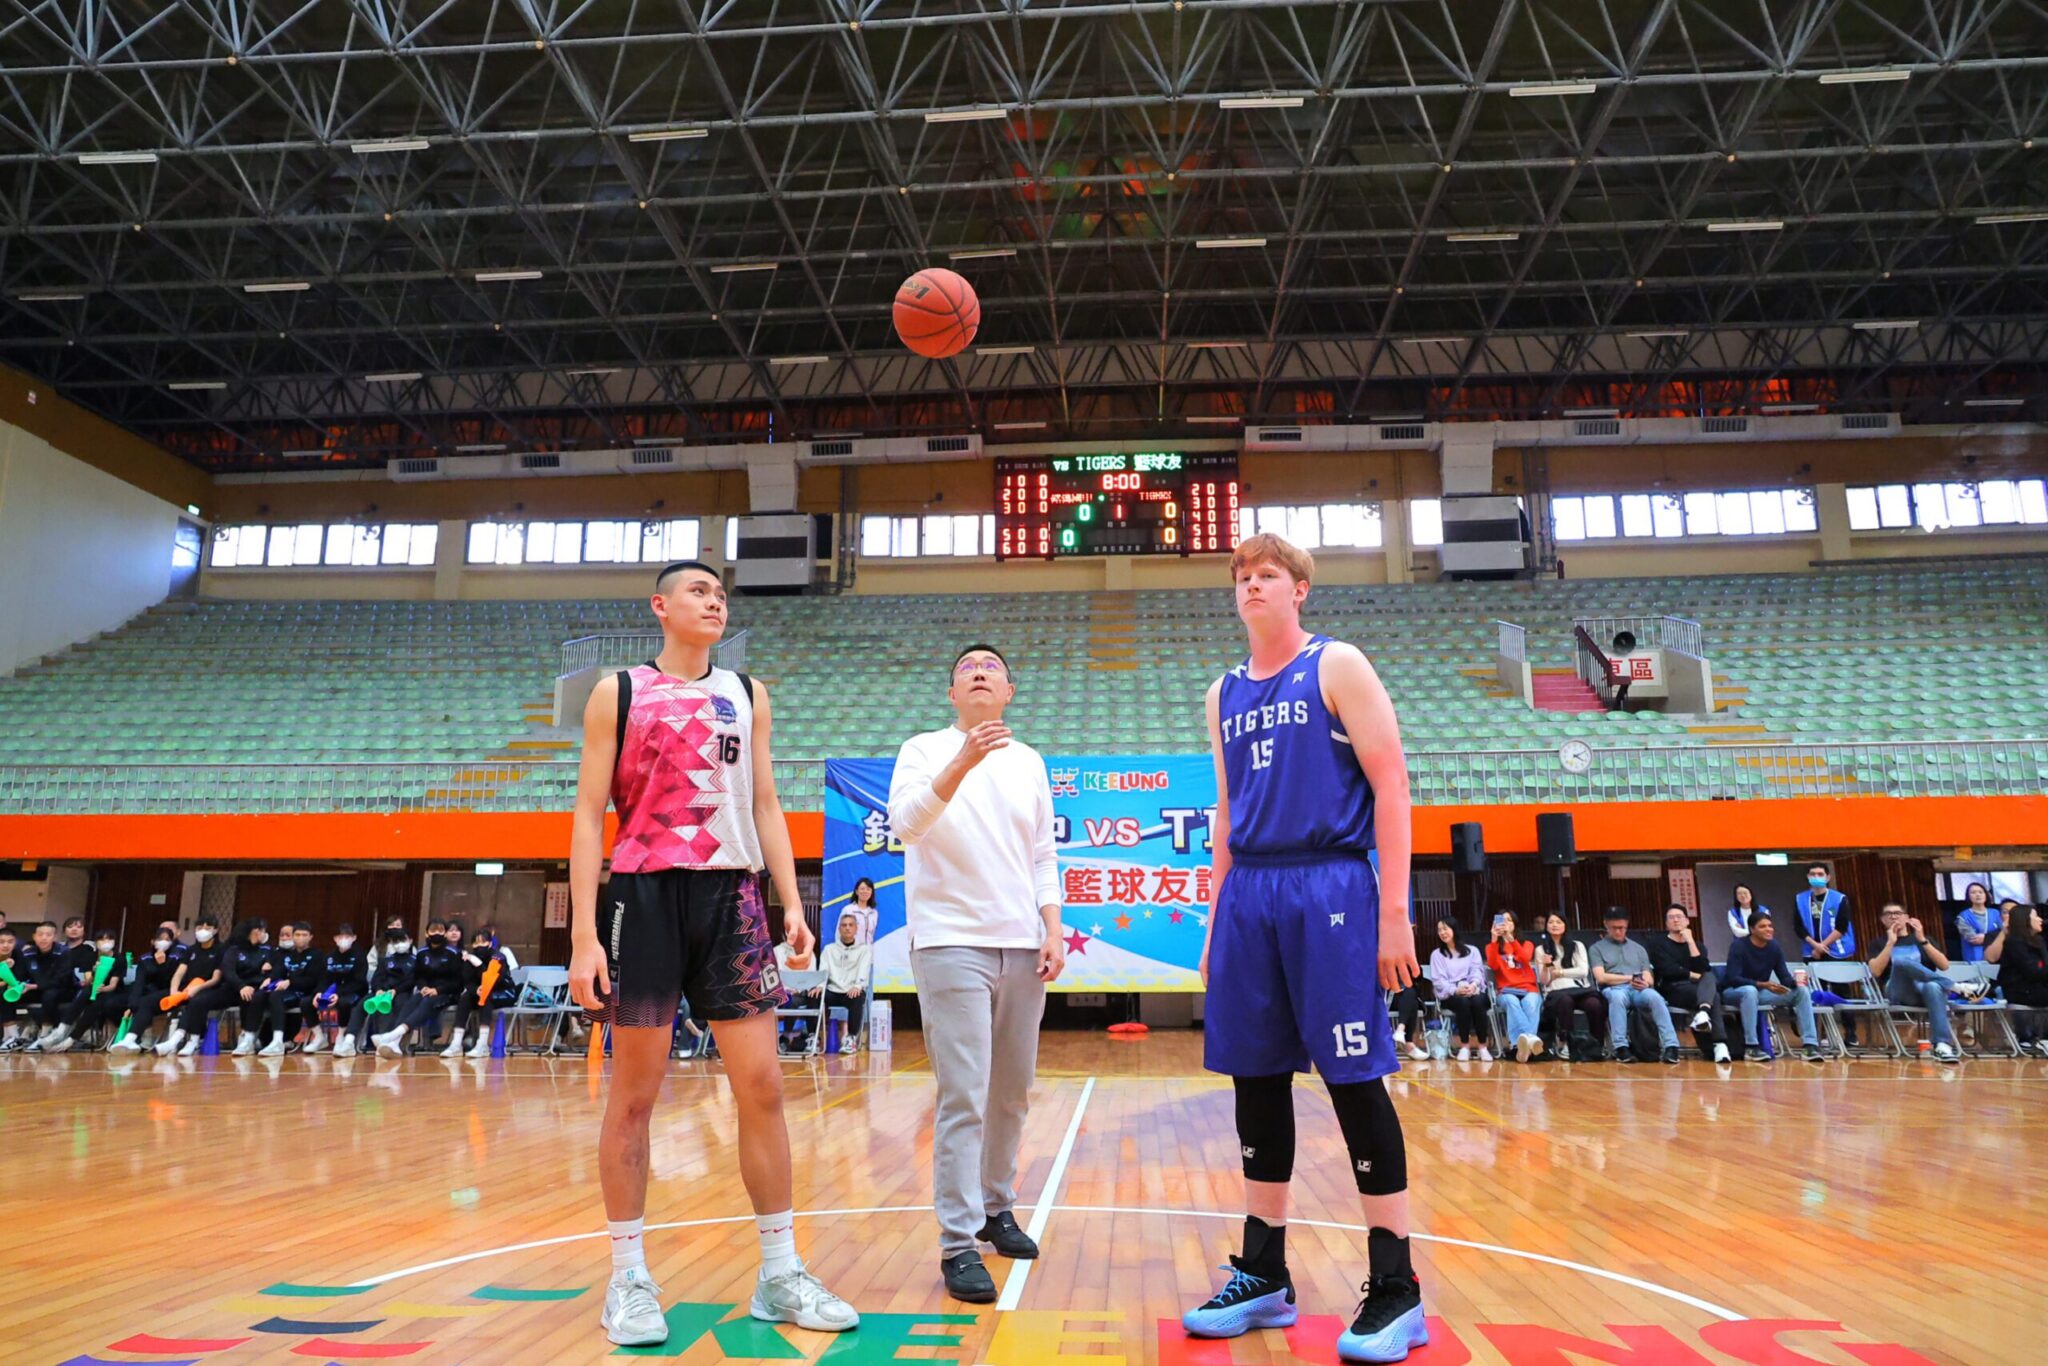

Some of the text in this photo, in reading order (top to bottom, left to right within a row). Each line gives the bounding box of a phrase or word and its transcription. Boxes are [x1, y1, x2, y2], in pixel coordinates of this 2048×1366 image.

[1076, 456, 1126, 471] TIGERS
[1018, 475, 1026, 487] 0
[1039, 474, 1048, 486] 0
[1102, 474, 1140, 490] 8:00
[1003, 489, 1011, 501] 2
[1018, 488, 1026, 500] 0
[1039, 487, 1048, 499] 0
[1191, 482, 1237, 495] 2 0 0
[1003, 501, 1048, 514] 3 0 0
[1165, 502, 1176, 518] 0
[1193, 496, 1238, 509] 3 0 0
[1078, 504, 1091, 521] 0
[1208, 510, 1216, 522] 0
[1230, 509, 1238, 521] 0
[1003, 528, 1048, 541] 5 0 0
[1164, 528, 1176, 544] 0
[1193, 523, 1239, 536] 5 0 0
[1062, 529, 1074, 546] 0
[1193, 538, 1201, 550] 6
[1209, 537, 1217, 549] 0
[1232, 537, 1240, 549] 0
[1003, 542, 1011, 554] 6
[1018, 542, 1026, 554] 0
[1040, 542, 1048, 553] 0
[1221, 700, 1308, 744] TIGERS
[717, 734, 741, 764] 16
[1250, 738, 1274, 770] 15
[1084, 771, 1168, 791] KEELUNG
[1332, 1021, 1368, 1058] 15
